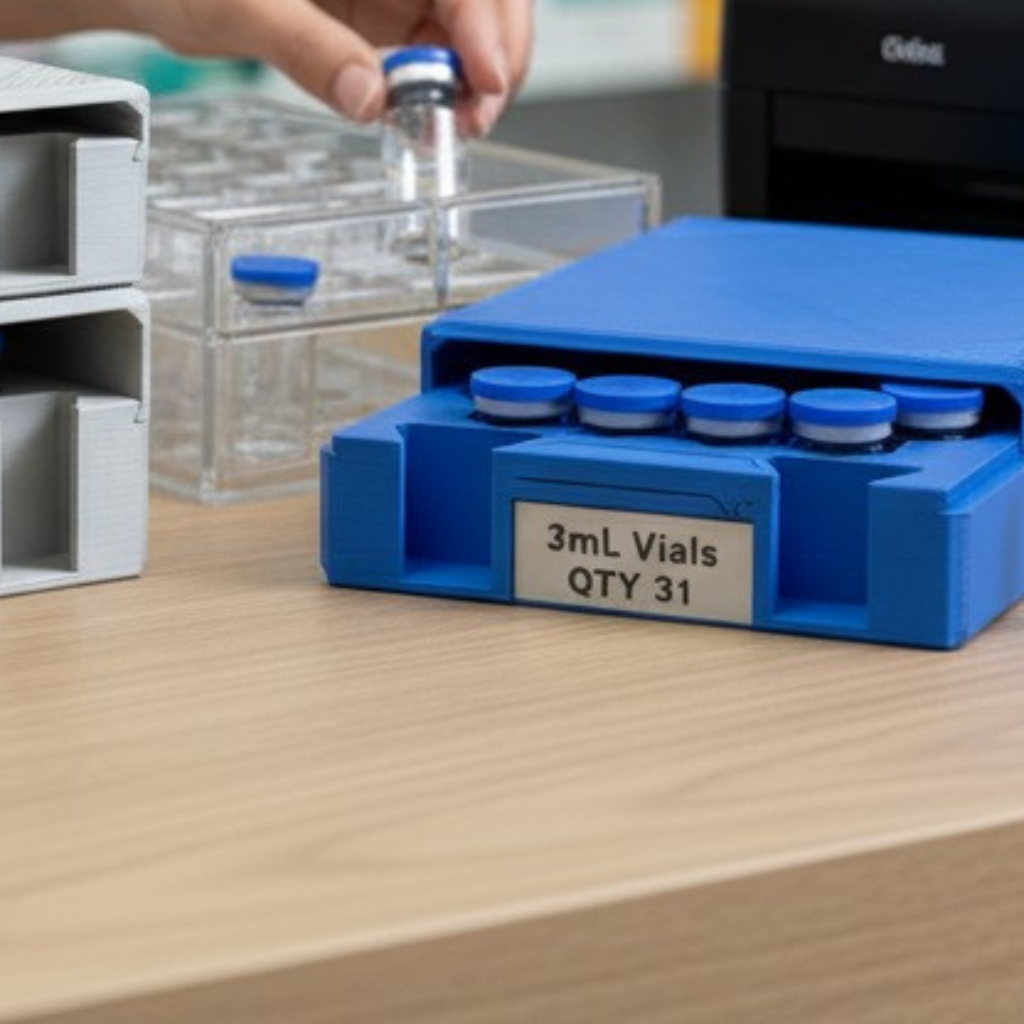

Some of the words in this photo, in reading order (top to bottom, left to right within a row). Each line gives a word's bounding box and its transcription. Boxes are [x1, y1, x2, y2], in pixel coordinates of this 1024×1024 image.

[547, 523, 621, 558] 3mL
[632, 531, 718, 568] Vials
[567, 566, 641, 601] QTY
[654, 575, 690, 606] 31
